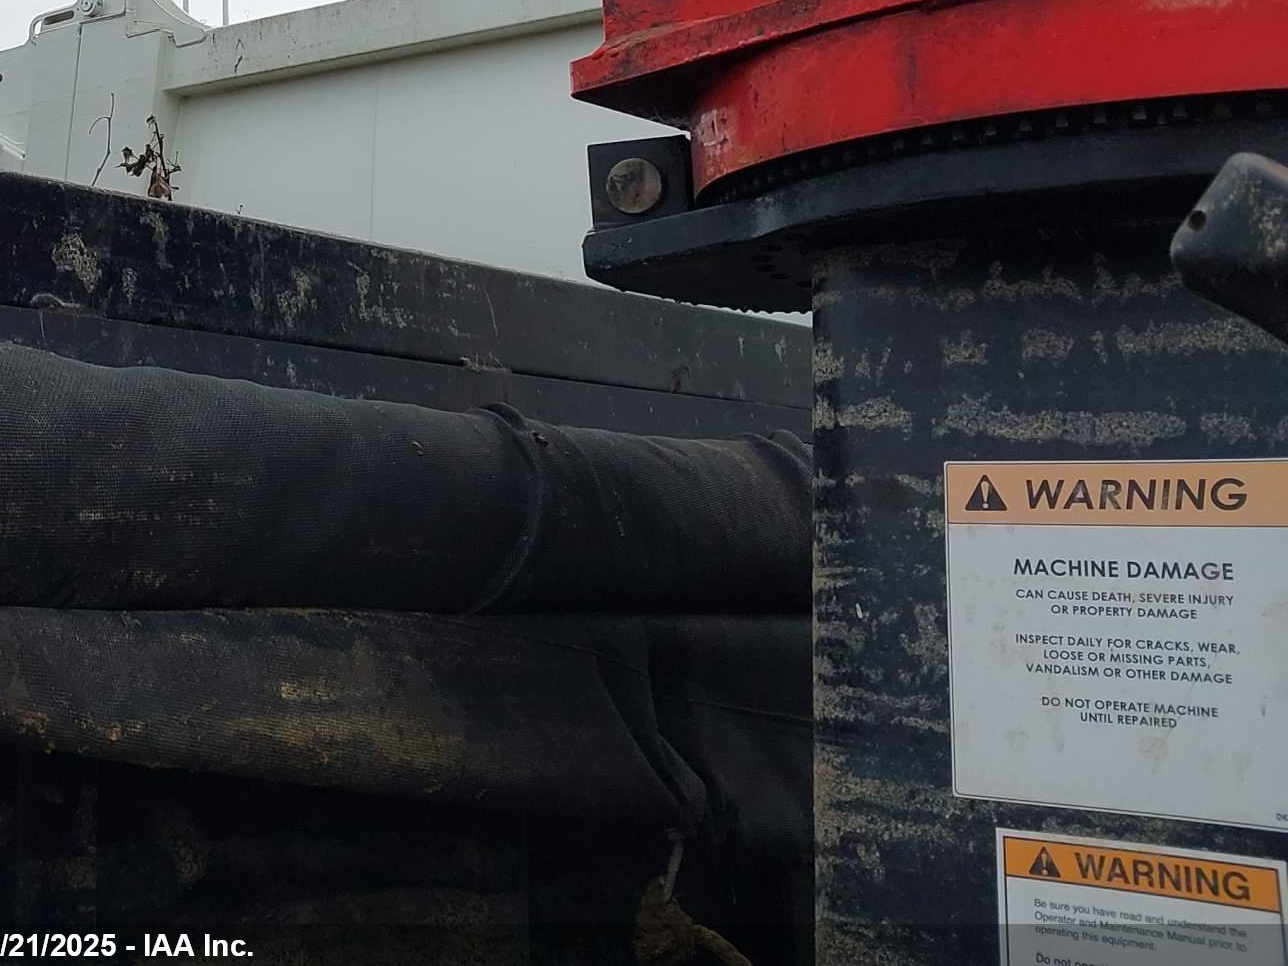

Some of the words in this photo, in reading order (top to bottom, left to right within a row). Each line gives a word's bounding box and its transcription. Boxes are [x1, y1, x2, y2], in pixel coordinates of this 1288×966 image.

[1025, 478, 1248, 511] WARNING
[1013, 558, 1119, 579] MACHINE
[1127, 561, 1234, 581] DAMAGE
[1015, 589, 1043, 600] CAN
[1047, 590, 1088, 602] CAUSE
[1092, 591, 1135, 604] DEATH,
[1139, 592, 1184, 605] SEVERE
[1188, 593, 1233, 606] INJURY
[1051, 604, 1069, 616] OR
[1072, 605, 1133, 618] PROPERTY
[1137, 607, 1197, 620] DAMAGE
[1015, 634, 1064, 646] INSPECT
[1067, 636, 1103, 648] DAILY
[1107, 638, 1131, 649] FOR
[1135, 639, 1194, 653] CRACKS,
[1043, 650, 1084, 662] LOOSE
[1087, 651, 1105, 663] OR
[1109, 653, 1163, 666] MISSING
[1168, 655, 1210, 669] PARTS,
[1026, 663, 1099, 677] VANDALISM
[1103, 667, 1122, 678] OR
[1126, 668, 1166, 681] OTHER
[1170, 671, 1232, 684] DAMAGE
[1041, 696, 1061, 707] DO
[1065, 697, 1091, 710] NOT
[1094, 699, 1150, 713] OPERATE
[1154, 703, 1219, 718] MACHINE
[1080, 712, 1113, 724] UNTIL
[1117, 714, 1177, 729] REPAIRED
[1075, 852, 1251, 901] WARNING
[1034, 898, 1047, 908] Be
[1050, 901, 1070, 911] sure
[1073, 905, 1090, 915] you
[1093, 906, 1117, 917] have
[1119, 911, 1142, 922] read
[1145, 915, 1164, 925] and
[1167, 918, 1226, 935] understand
[1229, 927, 1248, 938] the
[1034, 911, 1076, 925] Operator
[1079, 918, 1097, 928] and
[1100, 920, 1163, 939] Maintenance
[1167, 930, 1206, 945] Manual
[1208, 938, 1232, 949] prior
[1235, 941, 1248, 952] to
[1035, 925, 1079, 941] operating
[1081, 931, 1099, 942] this
[1036, 952, 1051, 964] Do
